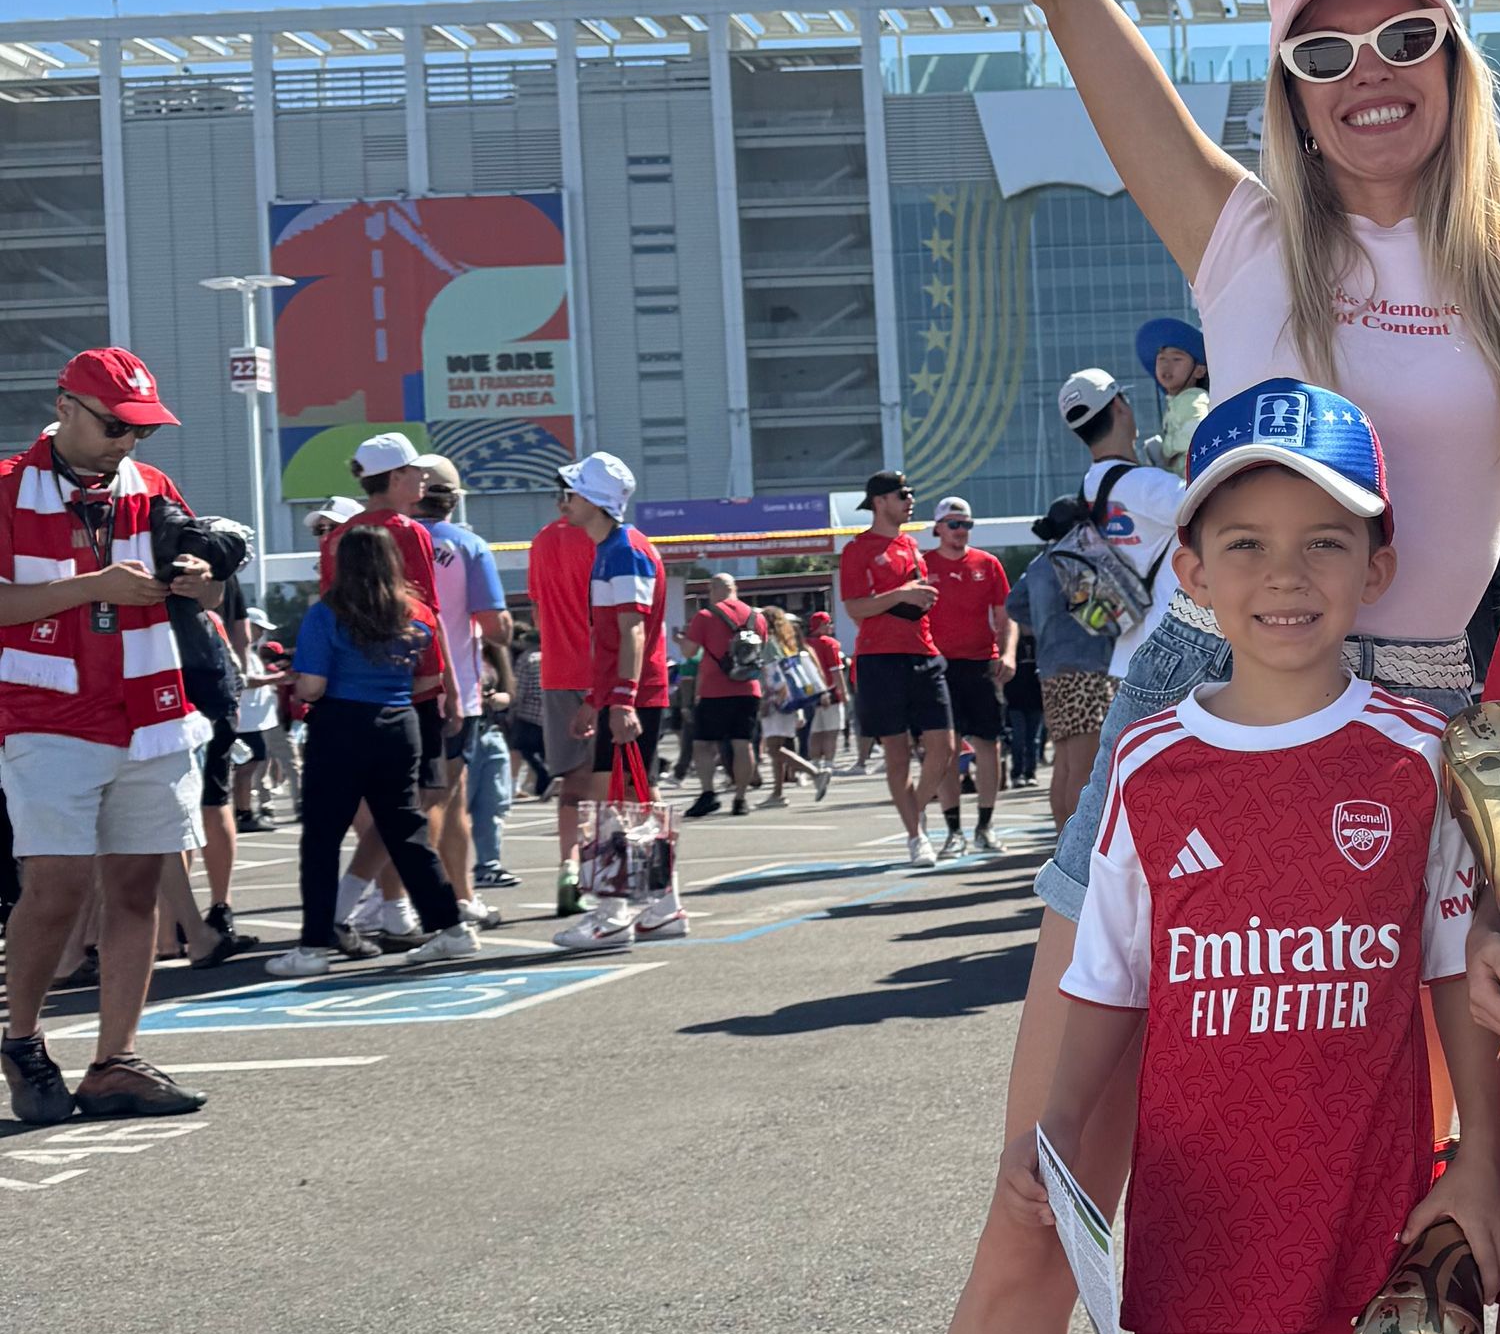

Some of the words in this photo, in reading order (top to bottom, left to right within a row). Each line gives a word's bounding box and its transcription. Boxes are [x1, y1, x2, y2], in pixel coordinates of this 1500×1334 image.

[1366, 298, 1462, 318] Memorie
[1362, 315, 1451, 336] Content
[233, 361, 255, 377] 22
[446, 354, 491, 374] WE
[447, 393, 491, 409] BAY
[496, 391, 556, 408] AREA
[1341, 811, 1383, 824] Arsenal
[1168, 915, 1401, 984] Emirates
[1191, 990, 1236, 1038] FLY
[1248, 981, 1369, 1034] BETTER
